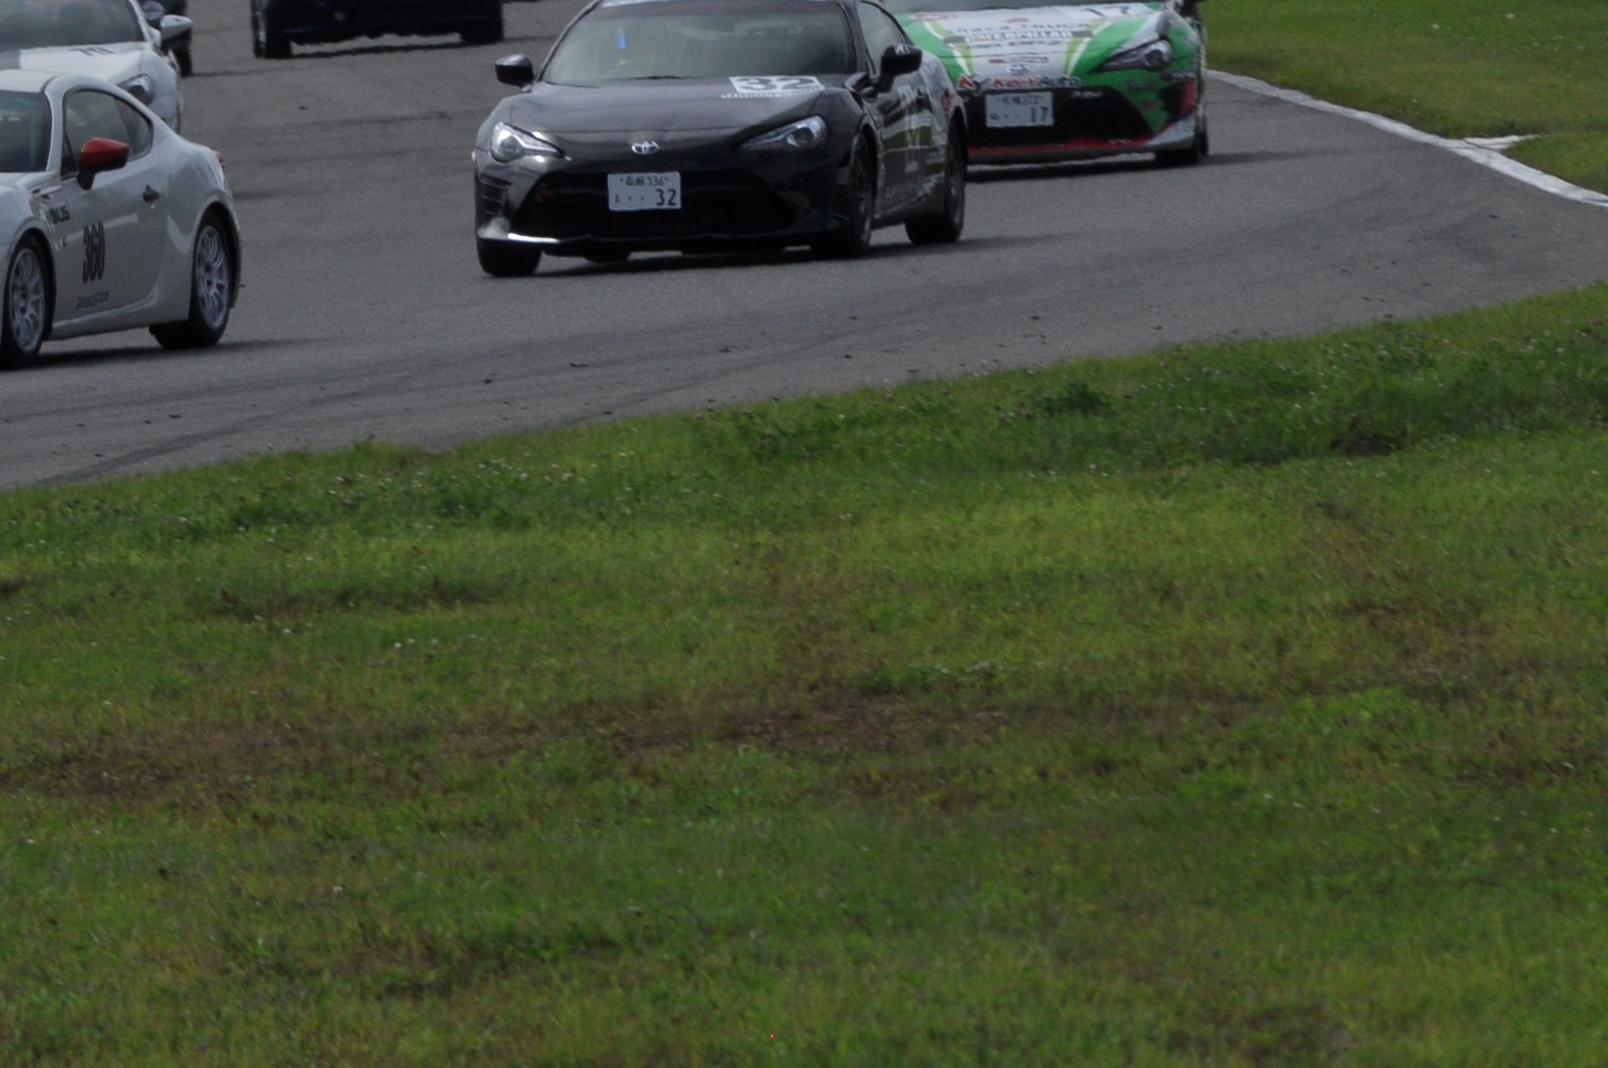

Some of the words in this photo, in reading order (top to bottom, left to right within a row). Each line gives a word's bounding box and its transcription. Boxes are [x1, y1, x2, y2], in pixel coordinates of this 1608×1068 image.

[735, 77, 815, 91] 32
[1031, 105, 1049, 124] 17
[655, 188, 677, 206] 32
[82, 221, 106, 283] 360
